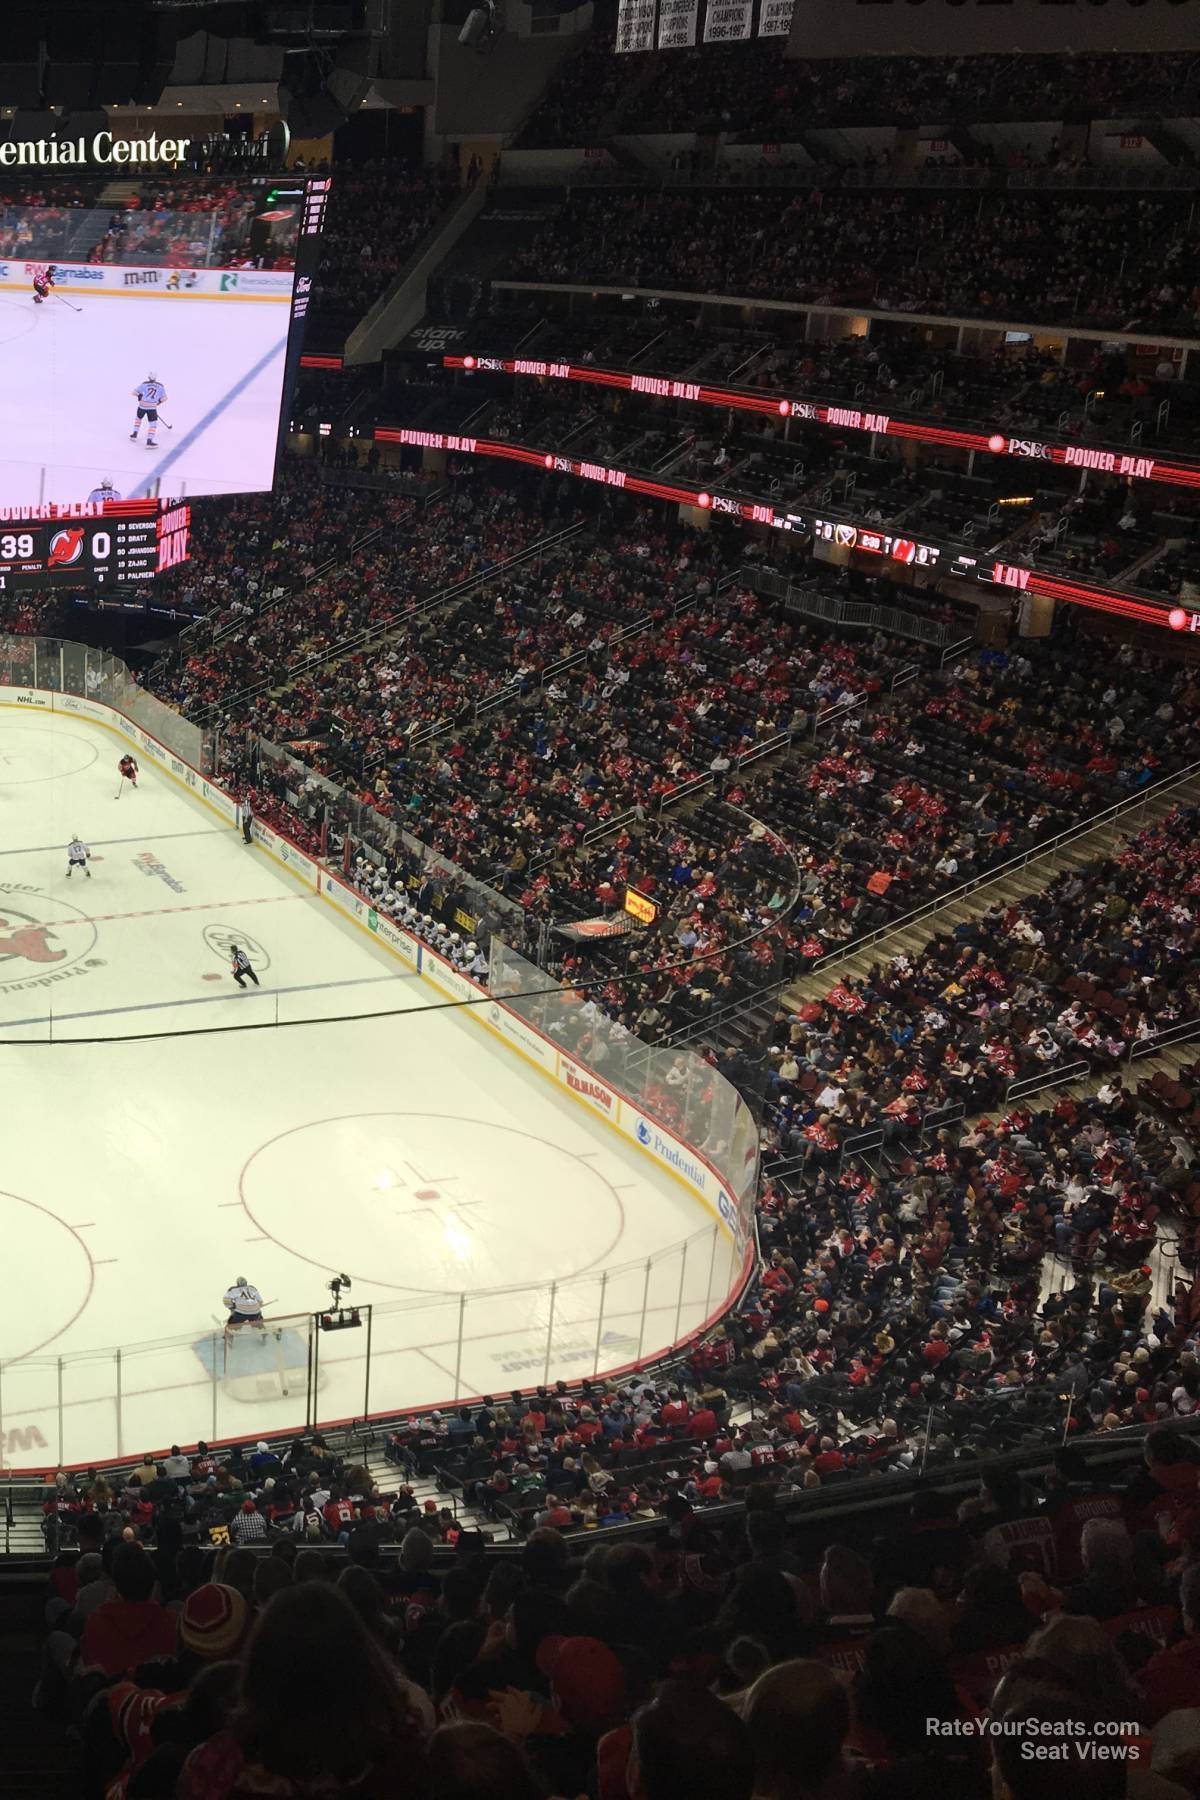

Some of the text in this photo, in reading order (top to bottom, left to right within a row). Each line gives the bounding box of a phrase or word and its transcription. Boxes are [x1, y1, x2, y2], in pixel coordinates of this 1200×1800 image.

[712, 8, 745, 24] CHAMPIONS
[766, 3, 793, 17] CHAMPION
[708, 24, 746, 38] 1996-1997
[93, 130, 191, 164] Center
[24, 262, 104, 281] RWBarnabas
[514, 360, 547, 376] POWER
[550, 363, 570, 378] PLAY
[827, 406, 861, 429] POWER
[864, 412, 890, 434] PLAY
[1008, 438, 1155, 479] PSEG POWER PLAY
[580, 462, 606, 482] POWER
[607, 467, 627, 488] PLAY
[161, 506, 187, 536] POWER
[92, 531, 111, 560] 0
[159, 530, 189, 571] PLAY
[128, 559, 148, 568] ZAJAC
[0, 576, 6, 589] 1
[127, 571, 155, 580] PALMIERI
[654, 1134, 706, 1191] Prudential
